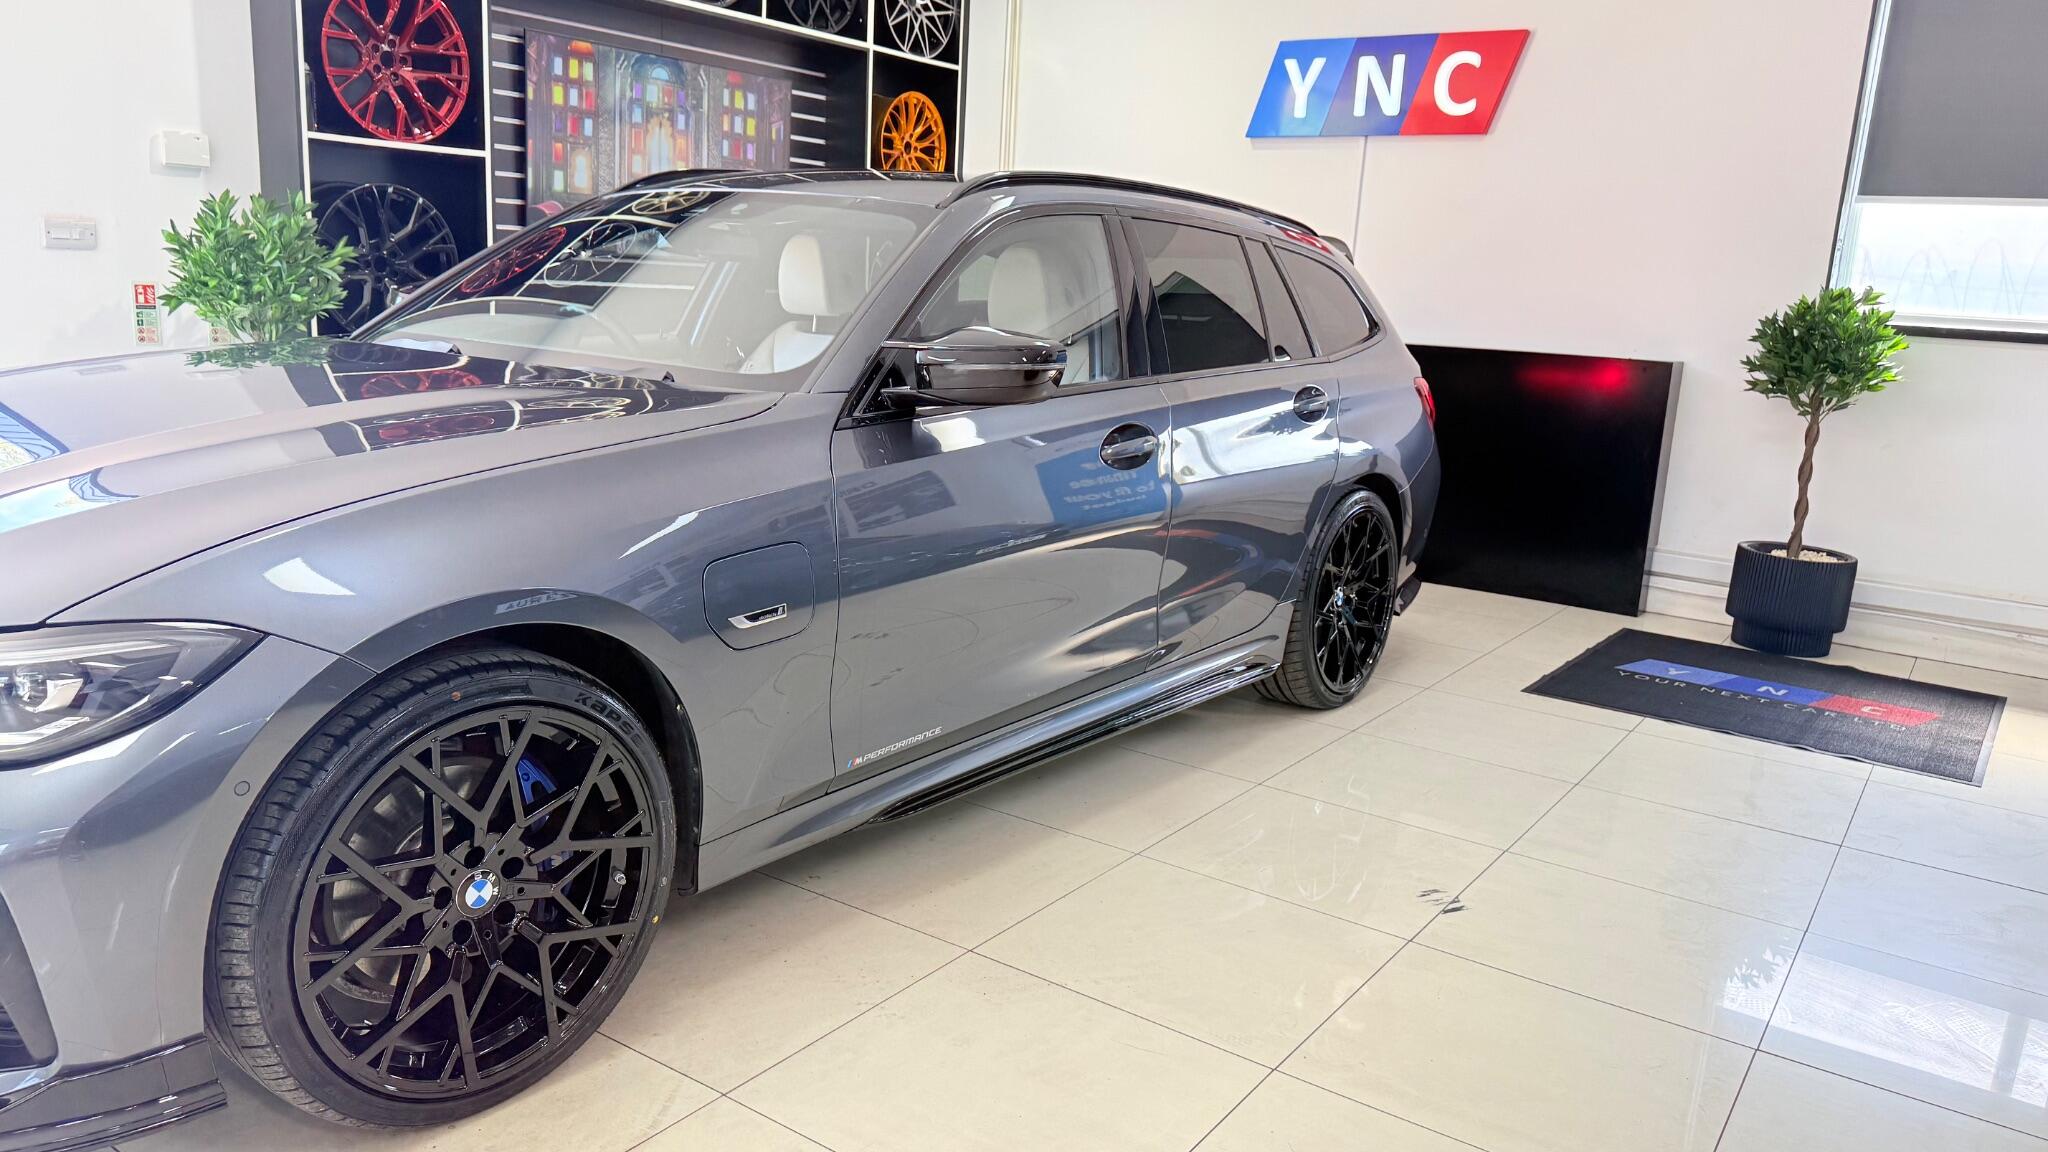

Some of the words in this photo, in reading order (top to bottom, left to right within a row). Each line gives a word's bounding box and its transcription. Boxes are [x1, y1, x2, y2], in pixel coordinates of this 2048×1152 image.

[1284, 50, 1482, 119] YNC
[1618, 670, 1687, 688] YOUR
[1700, 686, 1770, 704] NEXT
[1783, 703, 1838, 718] CAR
[1854, 717, 1907, 731] LTD
[863, 726, 943, 762] PERFORMANCE
